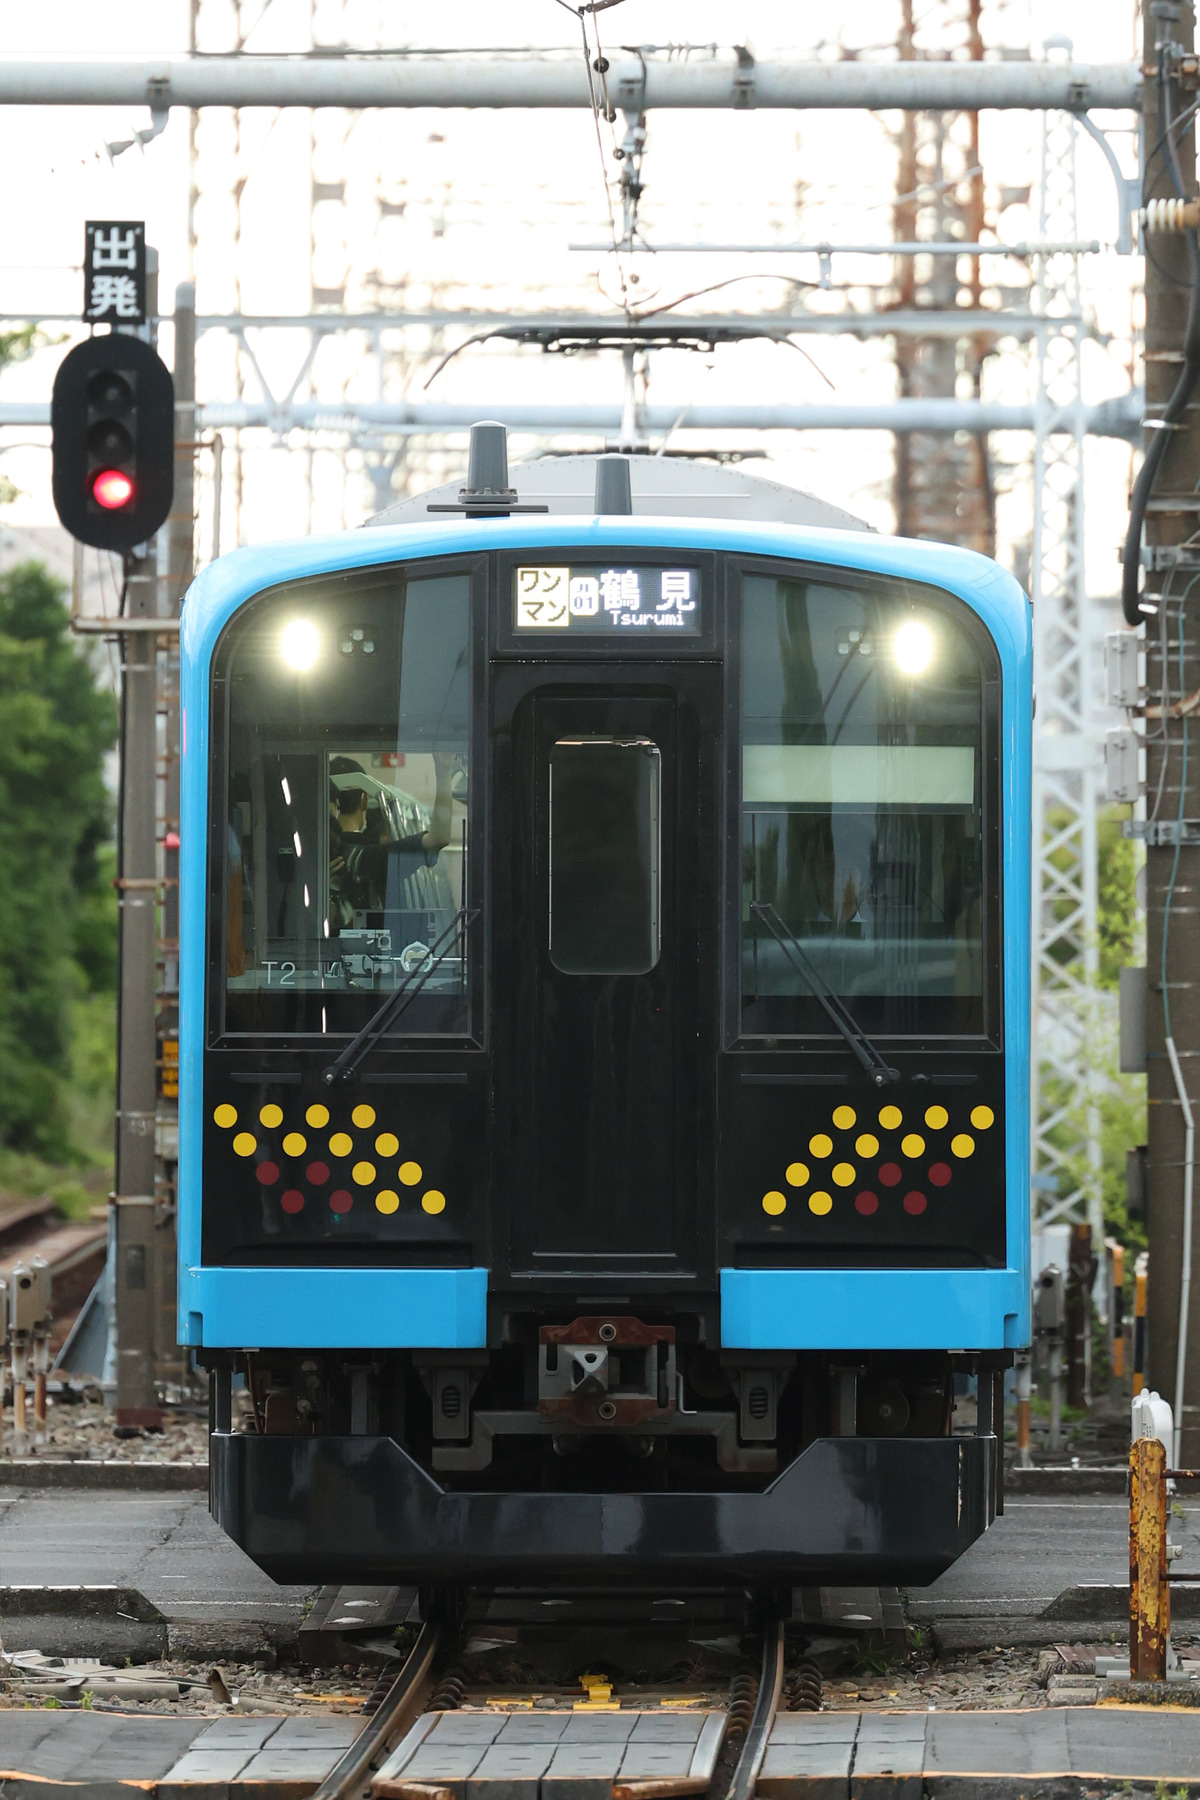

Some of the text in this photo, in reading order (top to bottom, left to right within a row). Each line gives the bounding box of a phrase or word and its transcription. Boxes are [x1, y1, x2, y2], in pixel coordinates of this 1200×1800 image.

[92, 226, 137, 317] 出発
[520, 570, 561, 593] ワン
[599, 570, 696, 611] 鶴見
[522, 601, 567, 622] マン
[574, 596, 593, 610] 01
[609, 610, 685, 626] Tsurumi
[261, 961, 296, 985] T2
